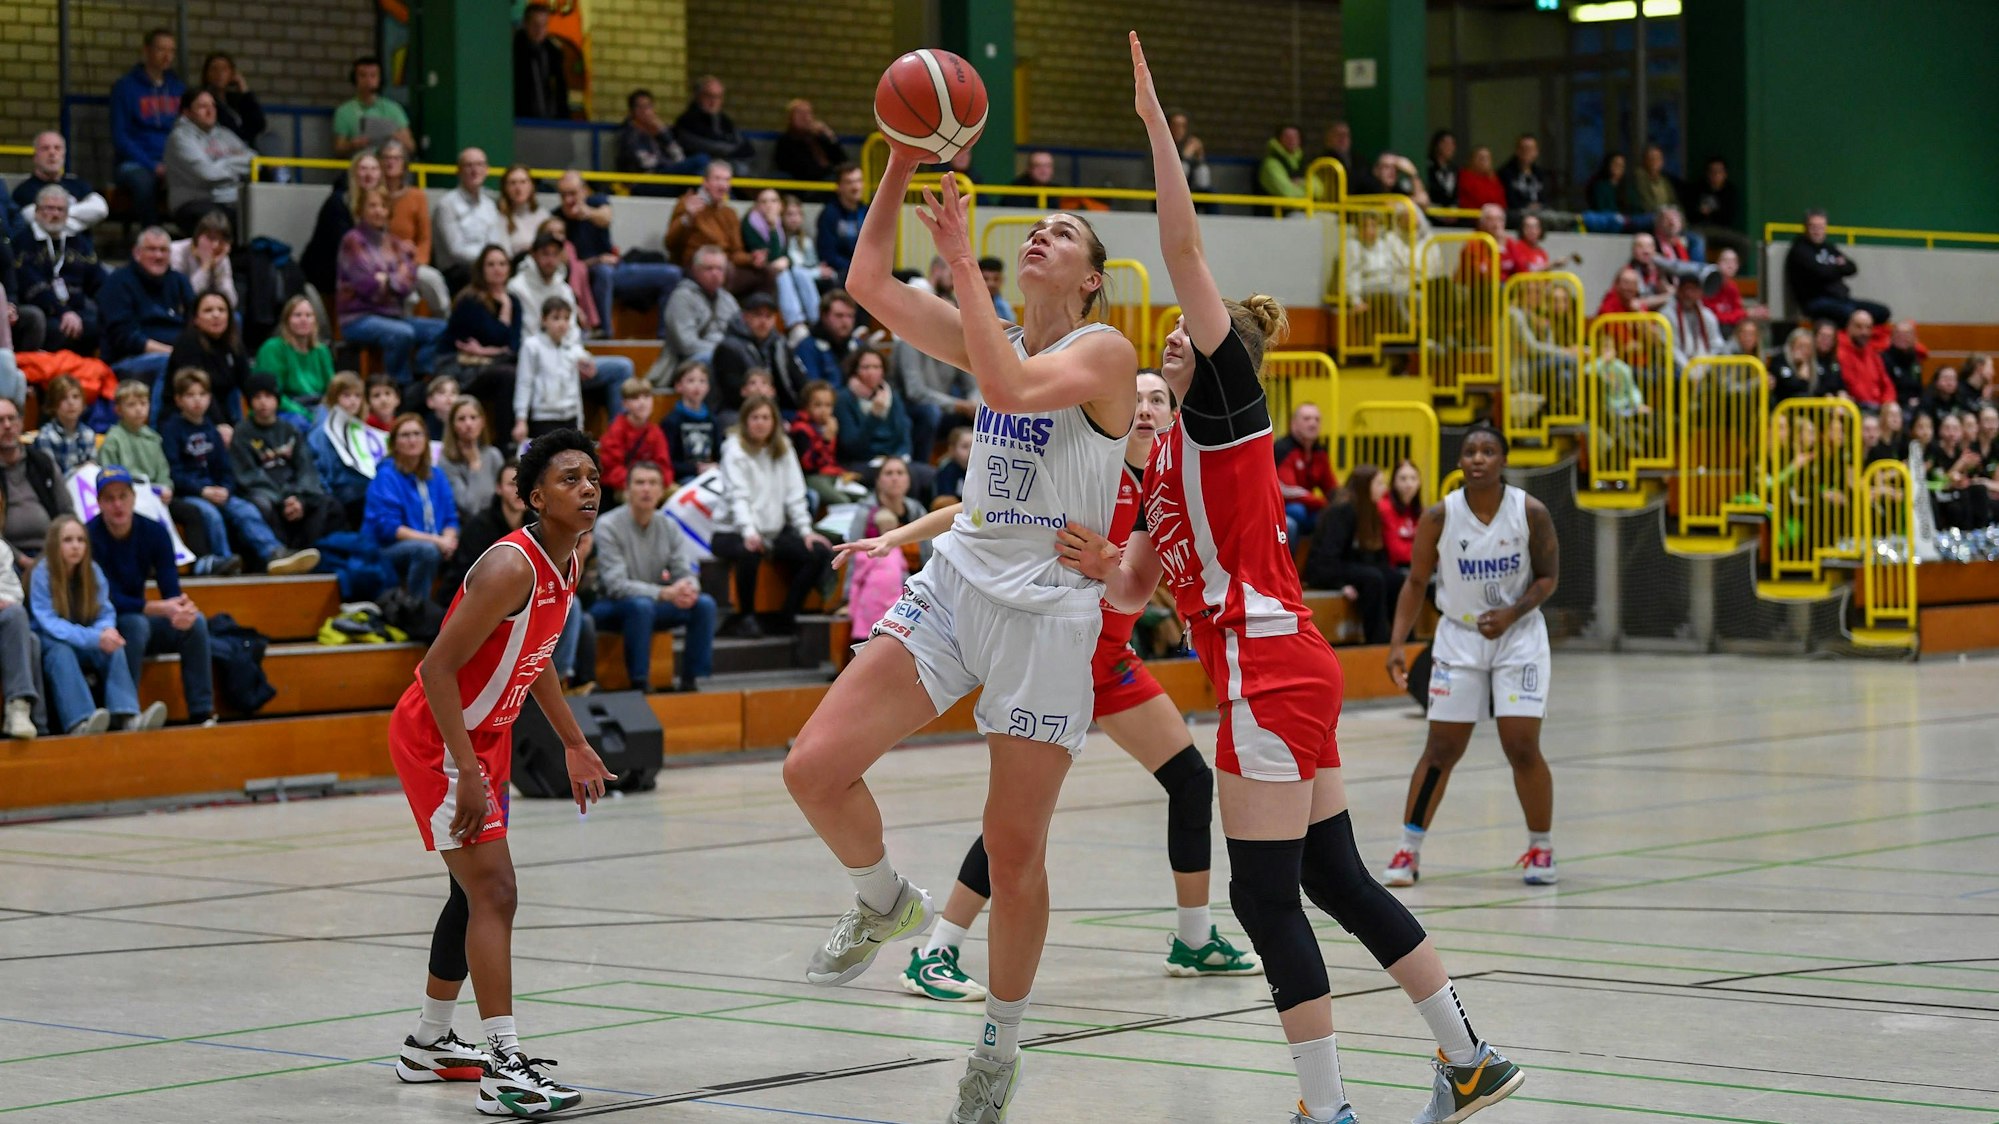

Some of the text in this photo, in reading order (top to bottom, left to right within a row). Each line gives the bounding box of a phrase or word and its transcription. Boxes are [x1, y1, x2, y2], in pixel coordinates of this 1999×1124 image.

[977, 404, 1054, 446] WINGS
[988, 455, 1037, 502] 27
[986, 507, 1068, 529] orthomol
[1458, 553, 1521, 575] WINGS
[1008, 707, 1068, 744] 27
